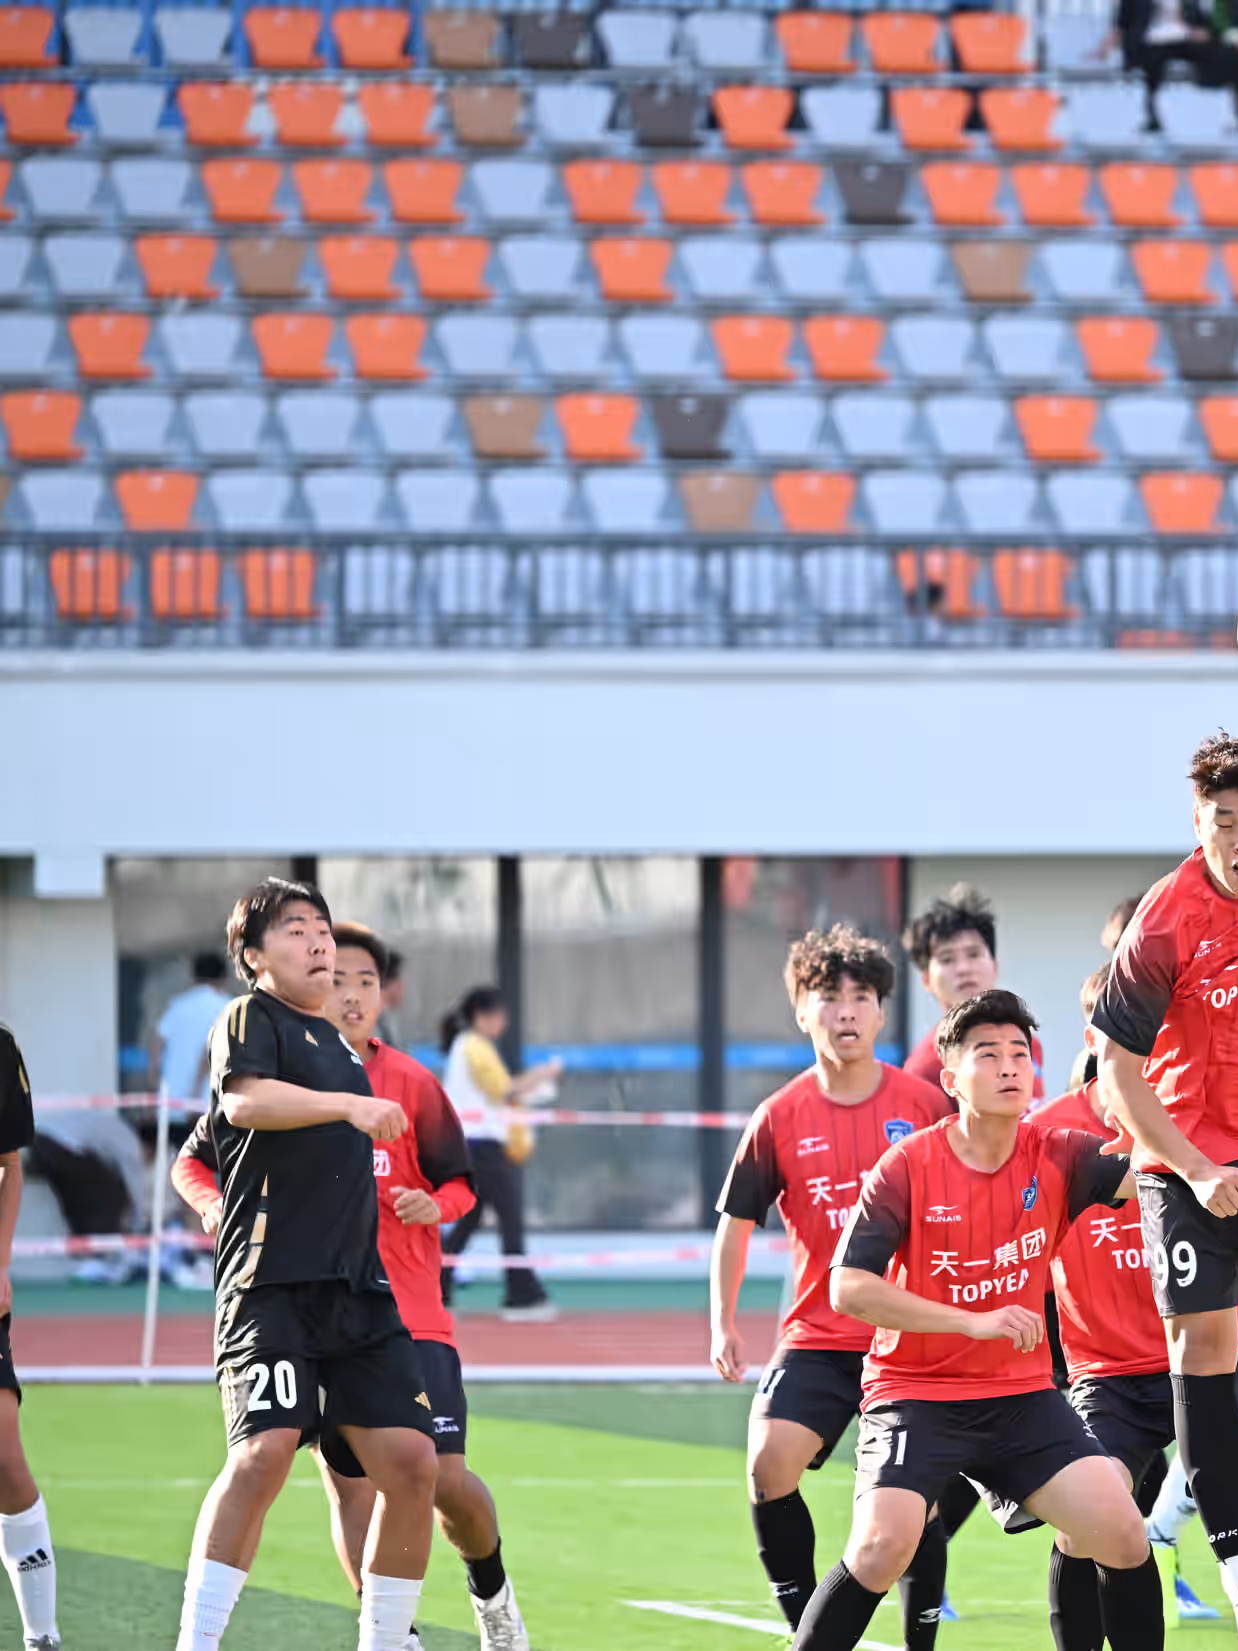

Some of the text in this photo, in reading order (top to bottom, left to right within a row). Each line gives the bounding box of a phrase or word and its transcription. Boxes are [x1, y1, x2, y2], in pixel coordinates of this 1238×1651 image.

[806, 1175, 866, 1205] 天一
[930, 1227, 1046, 1277] 天一集团
[1153, 1240, 1198, 1288] 99
[948, 1268, 1029, 1303] TOPYEA
[246, 1359, 298, 1413] 20
